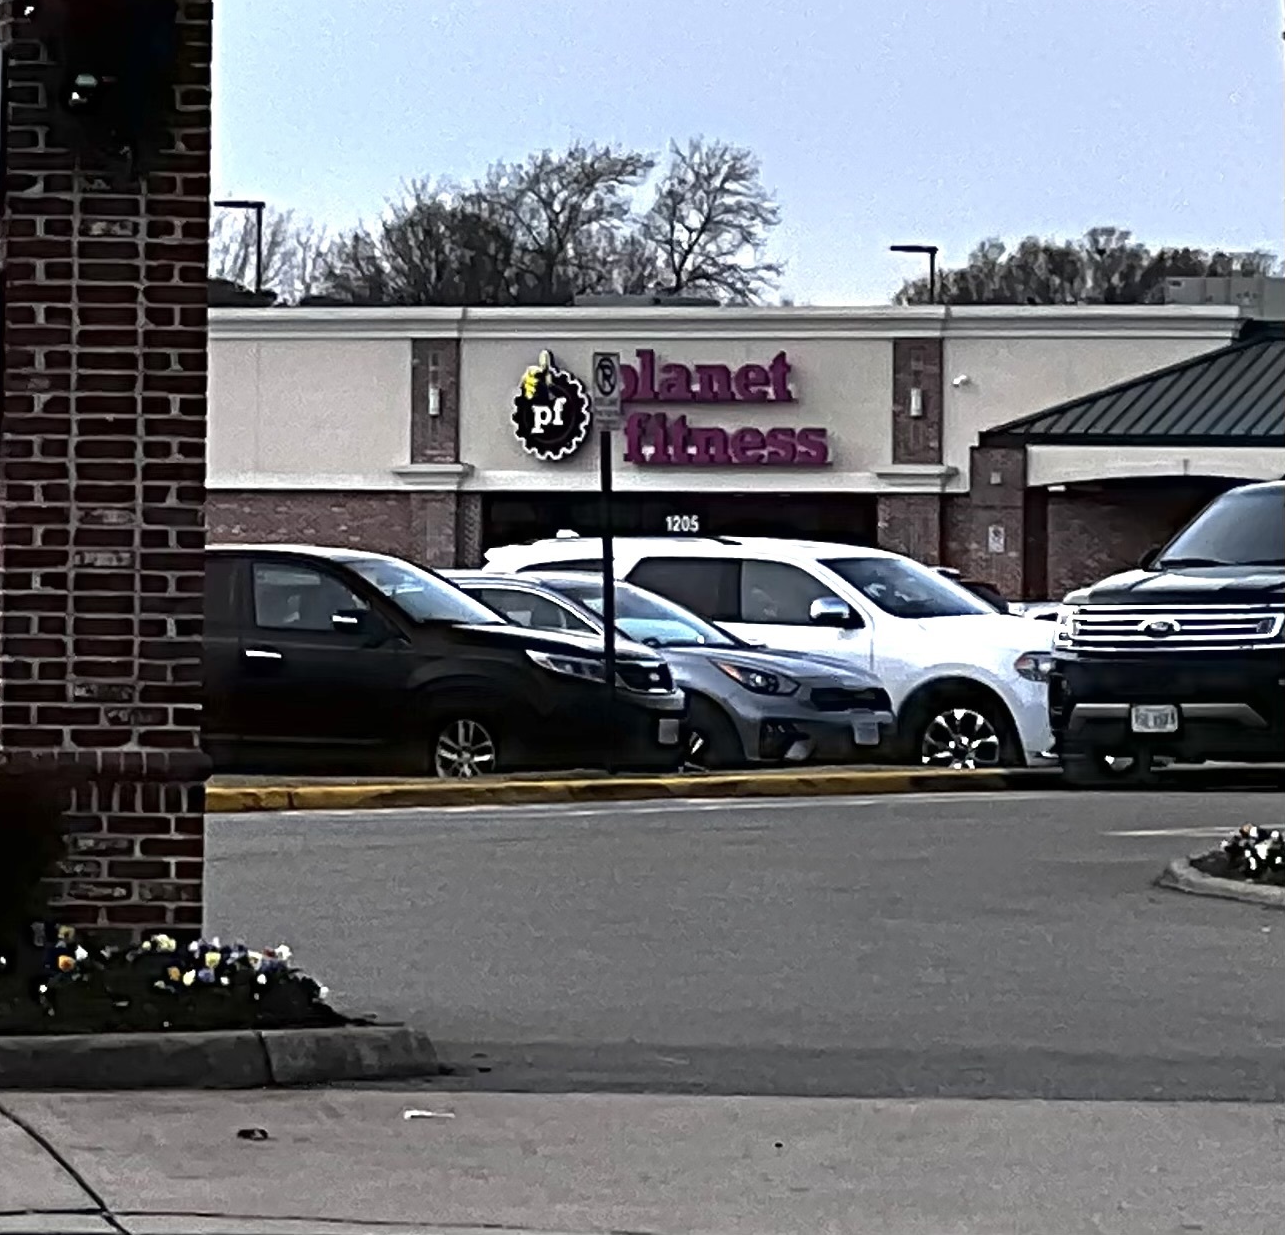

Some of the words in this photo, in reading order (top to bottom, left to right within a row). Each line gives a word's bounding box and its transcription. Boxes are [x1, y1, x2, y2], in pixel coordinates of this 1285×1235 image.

[530, 396, 567, 435] pf
[623, 411, 832, 465] fitness
[665, 514, 700, 533] 1205
